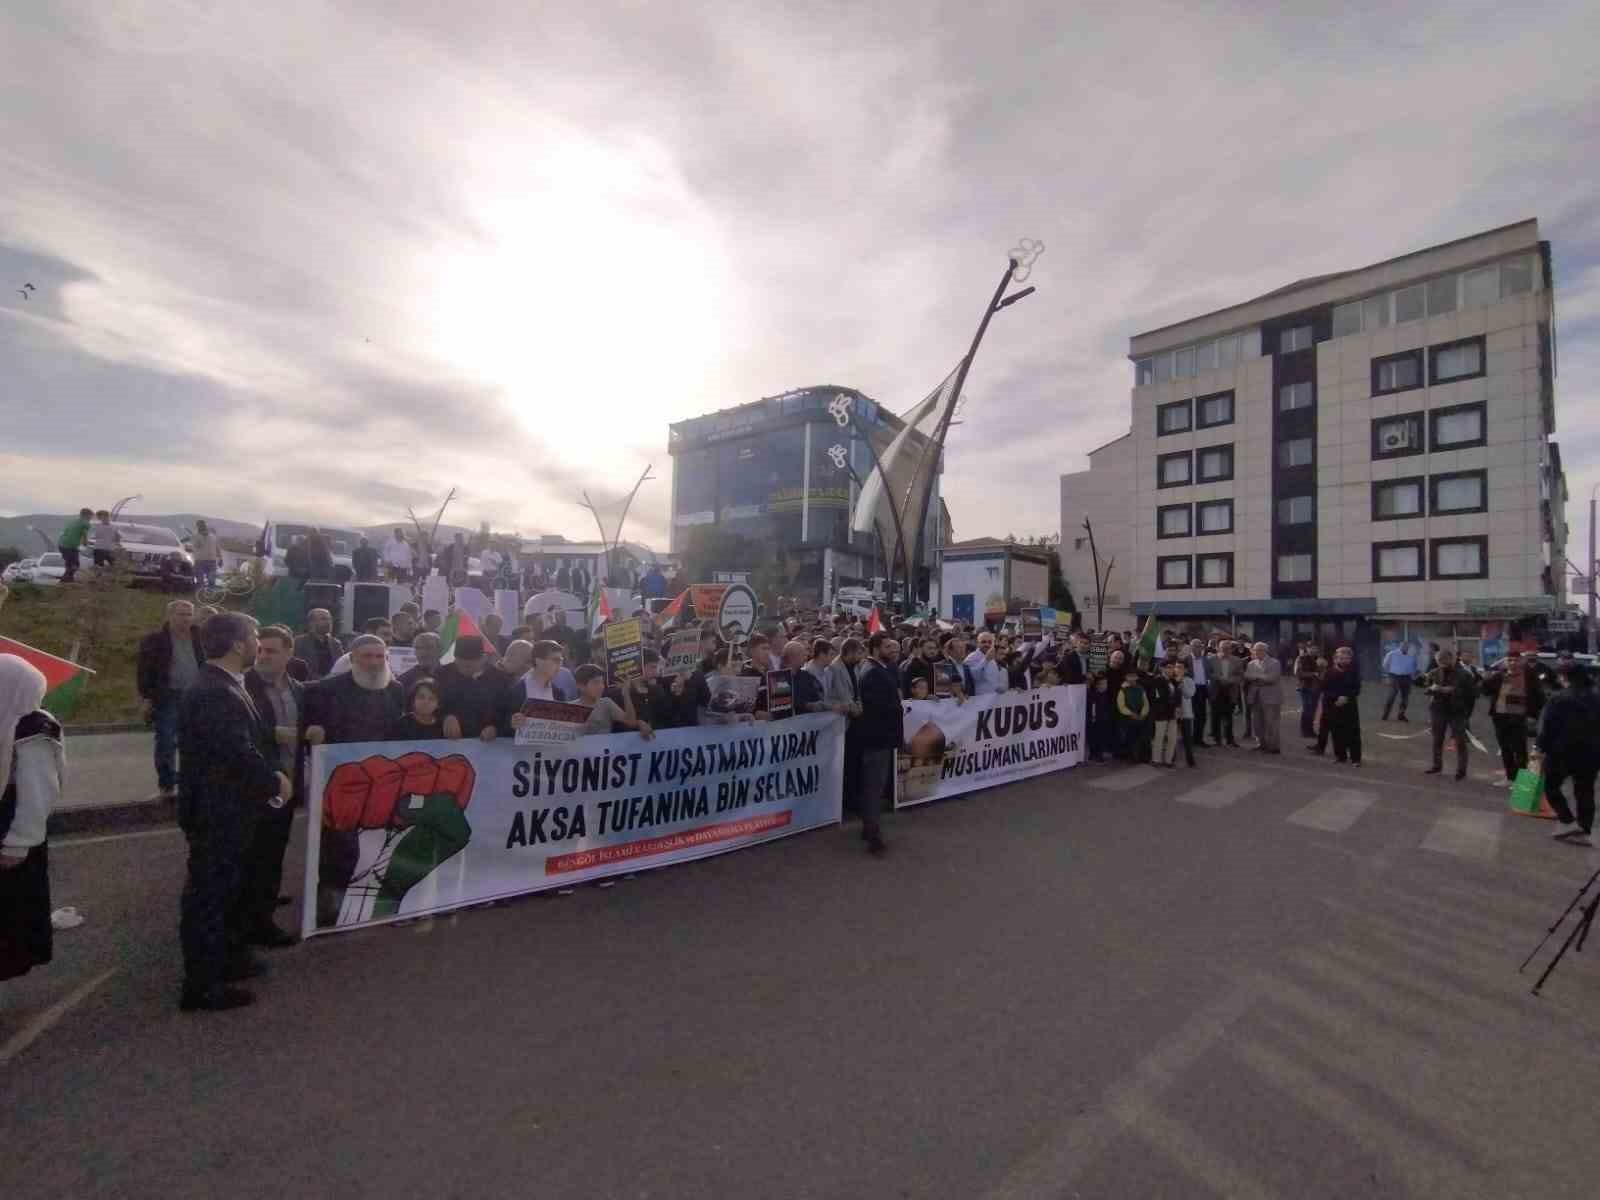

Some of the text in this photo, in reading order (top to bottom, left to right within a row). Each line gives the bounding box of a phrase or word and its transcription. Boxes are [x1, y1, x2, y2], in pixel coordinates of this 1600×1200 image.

[975, 694, 1059, 742] KUDÜS
[512, 748, 642, 798] SİYONİST
[648, 737, 765, 785] KUŞATMAYI
[506, 764, 820, 849] AKSA TUFANINA BİN SELAM!
